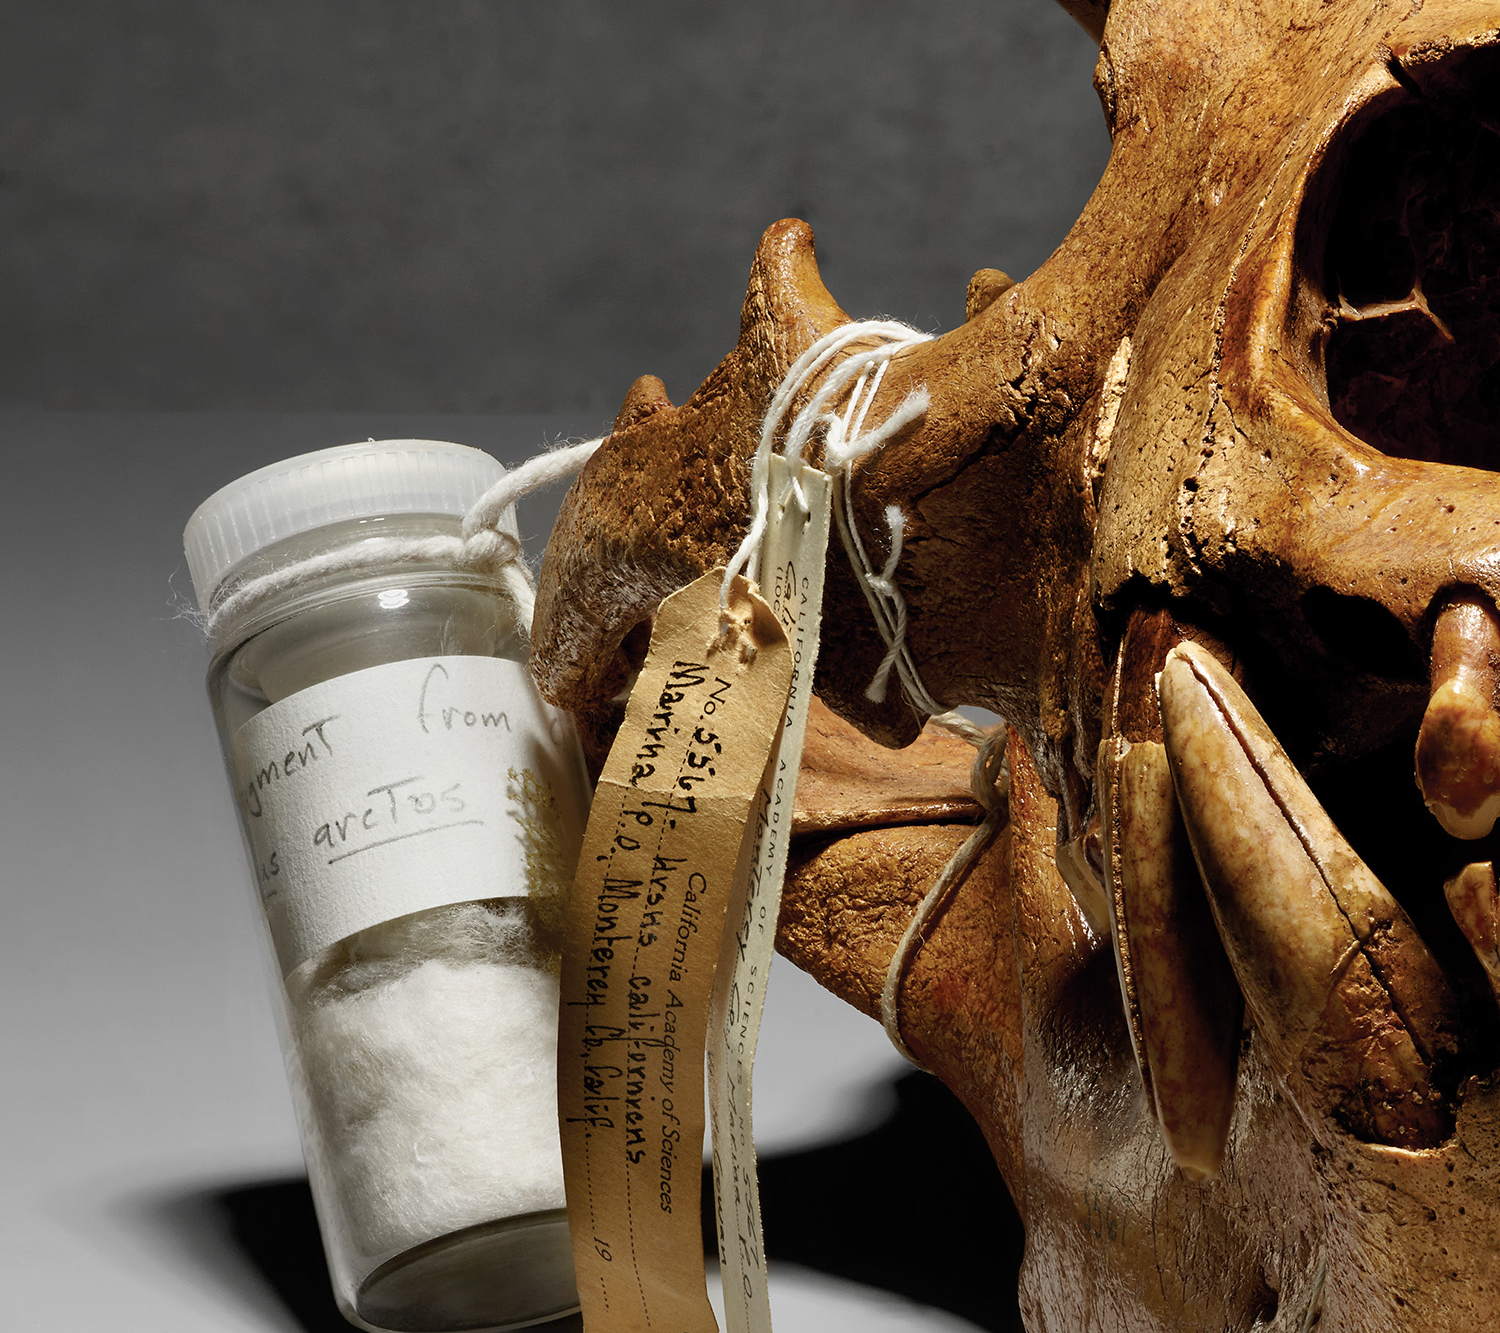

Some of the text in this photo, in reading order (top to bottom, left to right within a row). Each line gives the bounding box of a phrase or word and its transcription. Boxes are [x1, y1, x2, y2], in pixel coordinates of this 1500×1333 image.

[699, 676, 732, 720] No.
[784, 576, 810, 729] CALIFORNIA
[244, 663, 512, 819] gment from
[631, 660, 710, 787] Marina
[735, 788, 772, 962] Monterey
[765, 758, 787, 877] ACADEMY
[567, 878, 645, 1008] Monterey
[757, 905, 767, 935] OF
[659, 872, 707, 1214] California Academy of Sciences
[736, 964, 758, 1086] SCIENCES
[725, 1072, 741, 1206] Marina
[593, 1236, 613, 1262] 19
[741, 1166, 760, 1270] 5567
